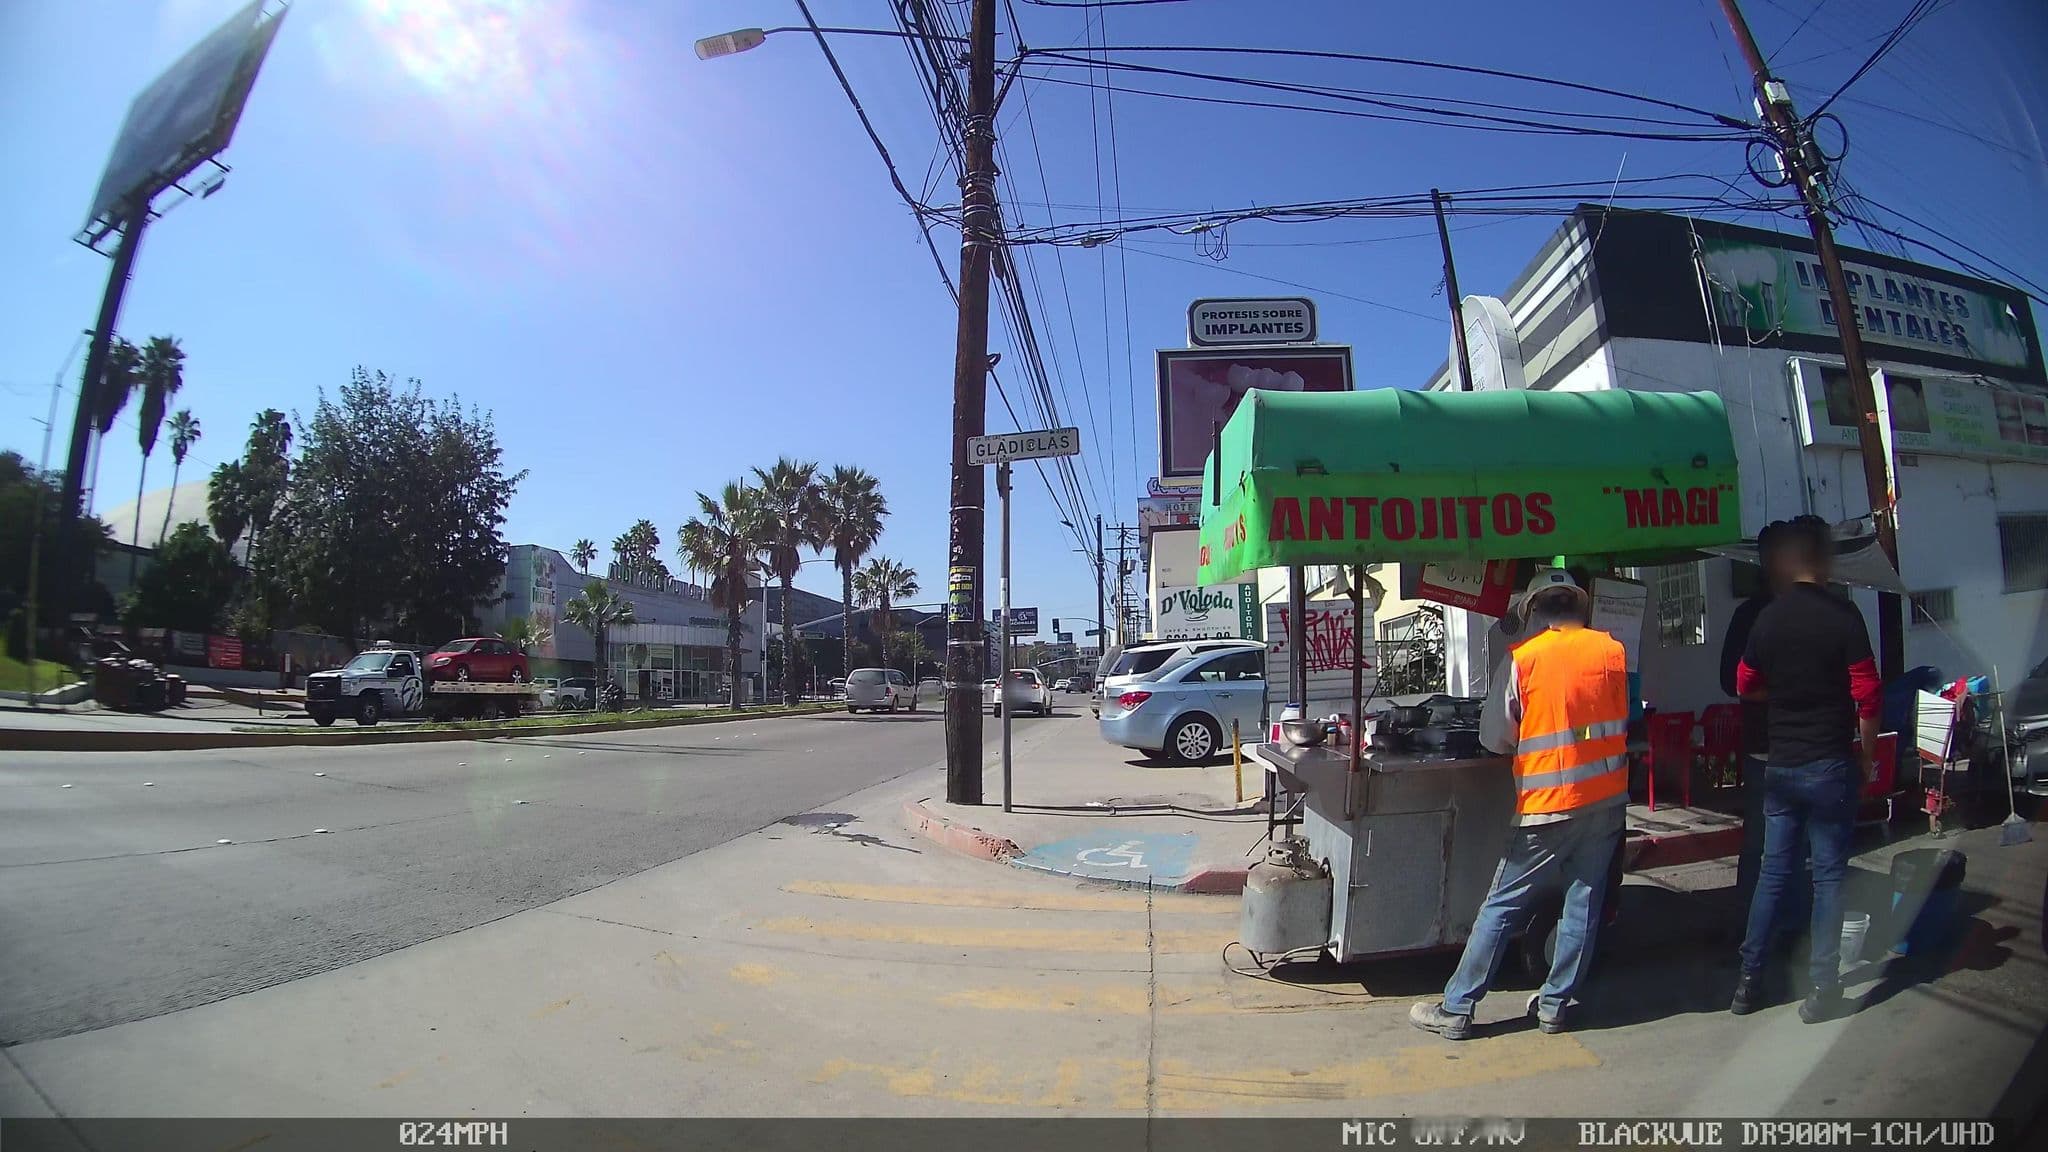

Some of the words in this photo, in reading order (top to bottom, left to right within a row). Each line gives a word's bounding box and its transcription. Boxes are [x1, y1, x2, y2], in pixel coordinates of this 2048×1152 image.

[1202, 310, 1260, 320] PROTESIS
[1263, 309, 1302, 318] SOBRE
[1205, 322, 1304, 335] IMPLANTES
[976, 436, 1070, 457] GLADIOLAS
[1269, 495, 1556, 541] ANTOJITOS
